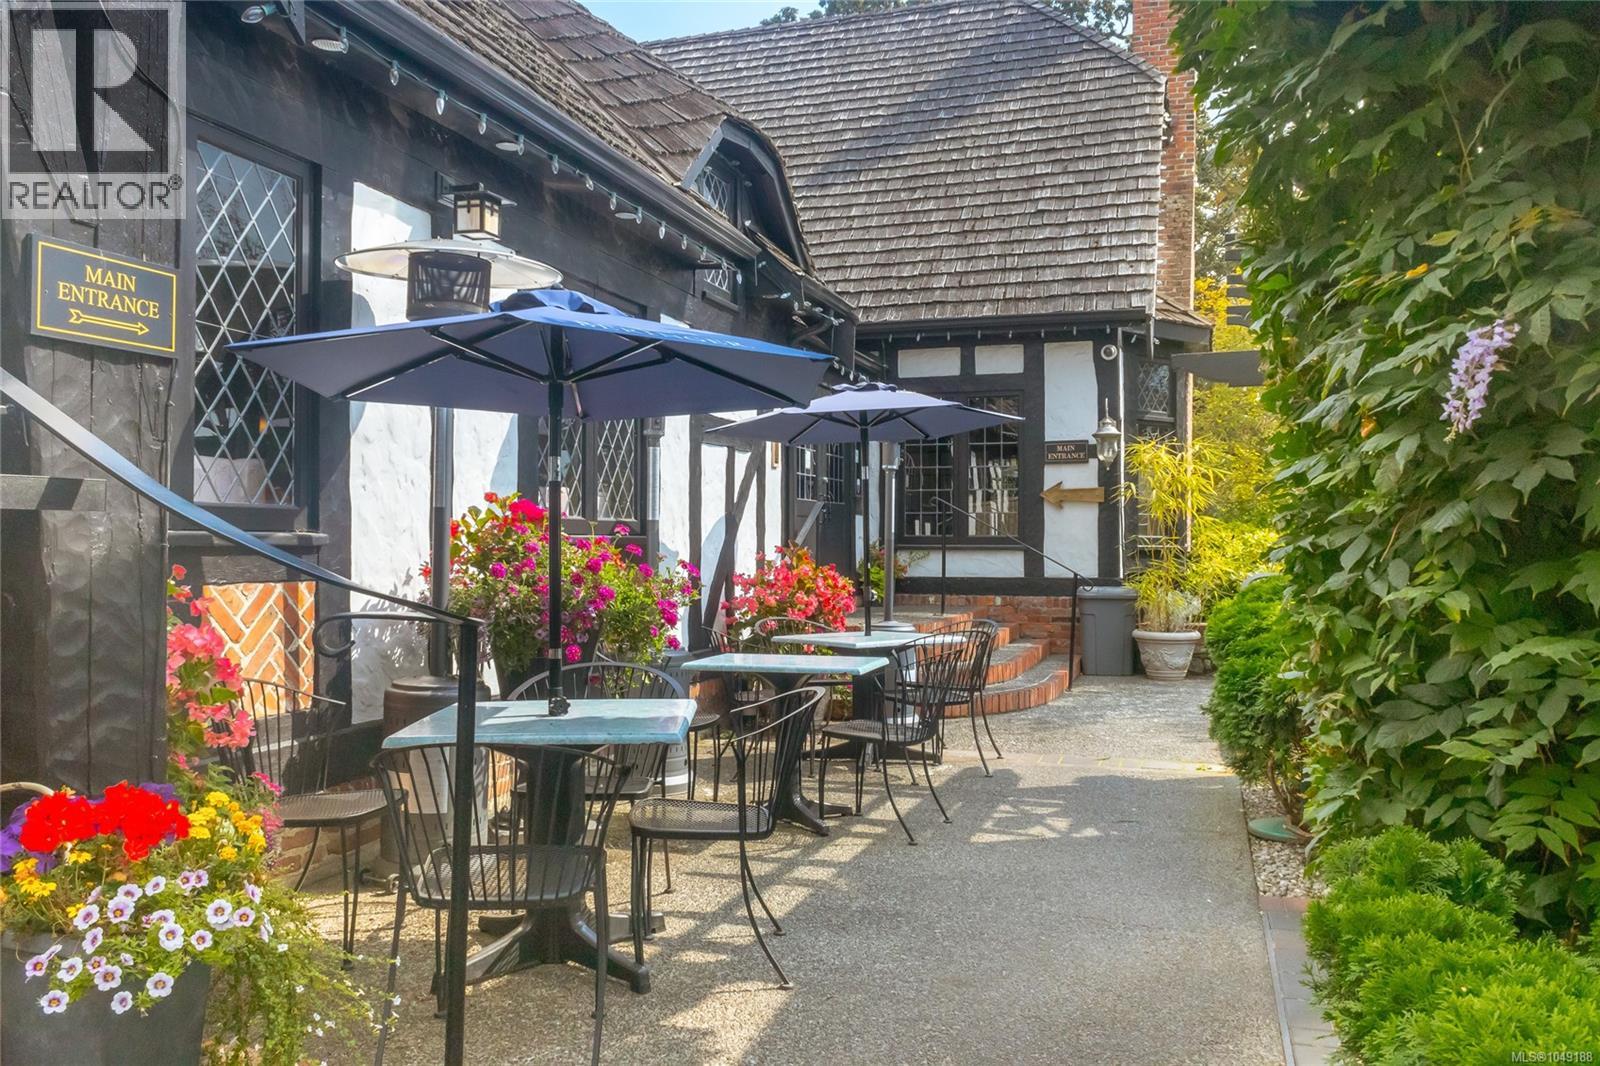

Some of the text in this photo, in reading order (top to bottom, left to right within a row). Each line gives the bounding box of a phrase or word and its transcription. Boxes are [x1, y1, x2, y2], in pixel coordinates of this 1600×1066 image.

[85, 264, 136, 292] MAIN
[57, 281, 160, 319] ENTRANCE
[1047, 452, 1085, 460] ENTRANCE
[1056, 444, 1075, 452] MAIN
